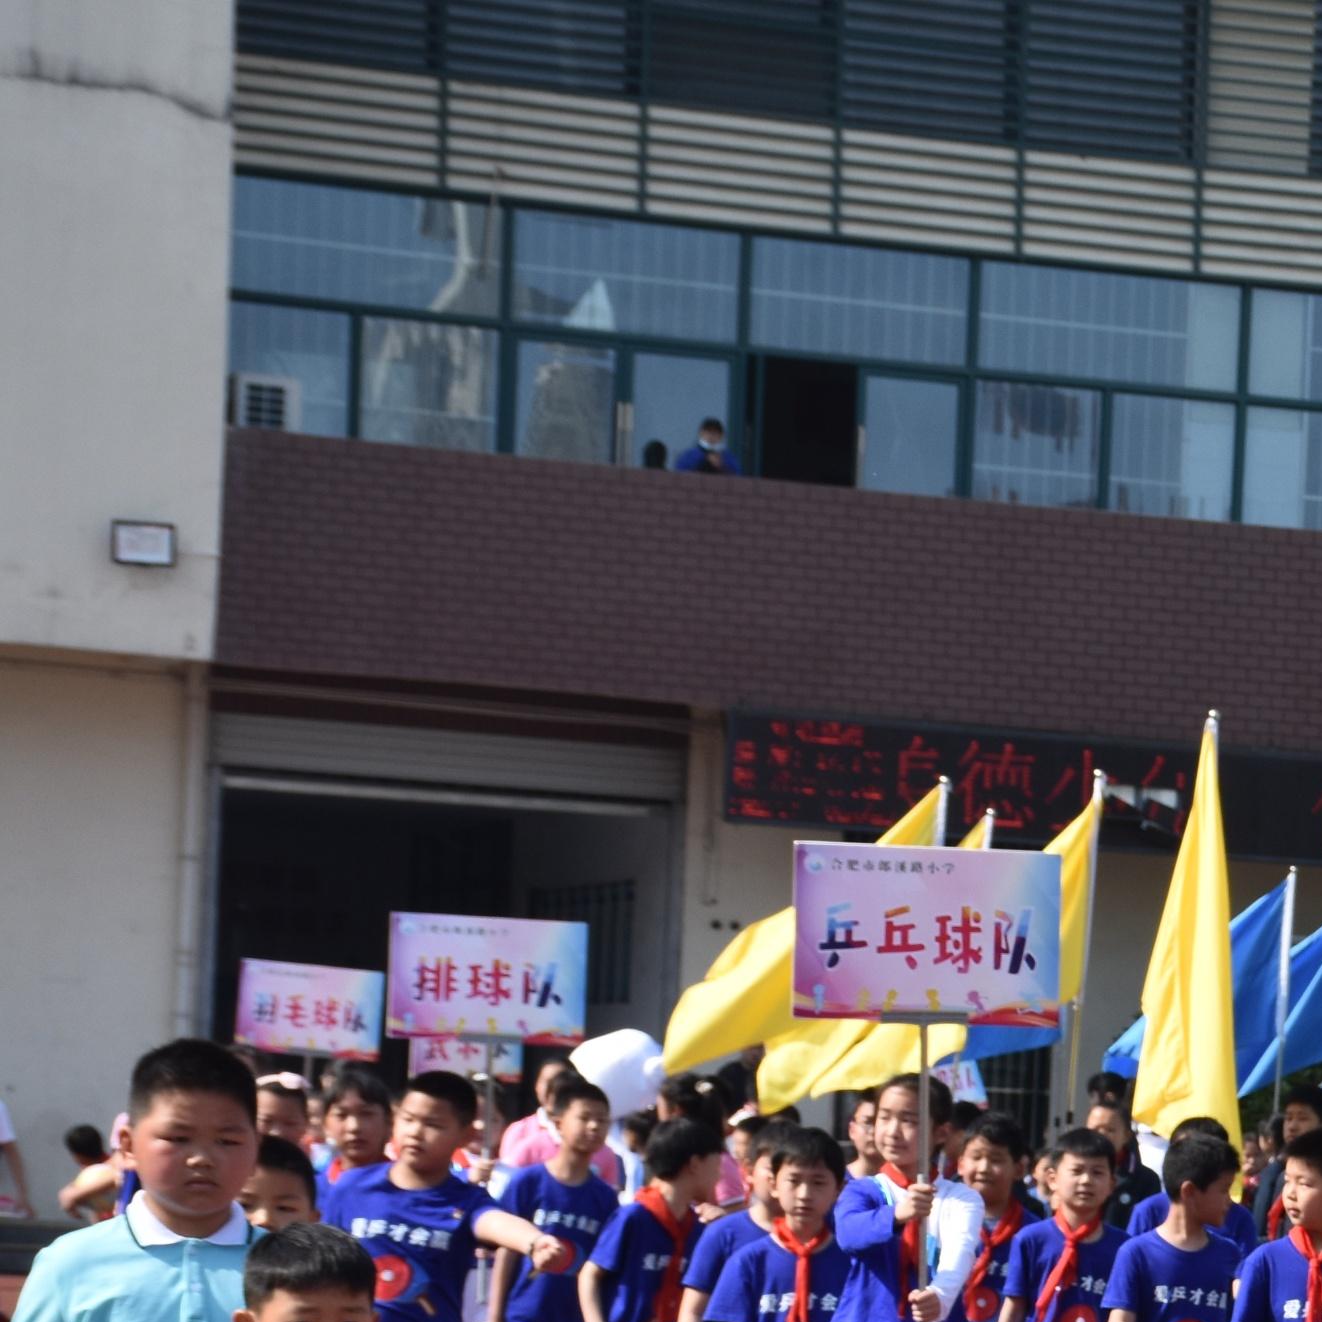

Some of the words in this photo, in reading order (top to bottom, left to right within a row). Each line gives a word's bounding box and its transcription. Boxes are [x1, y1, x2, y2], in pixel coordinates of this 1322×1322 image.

[819, 902, 1037, 975] 乒乓球队
[413, 955, 563, 1009] 排球队
